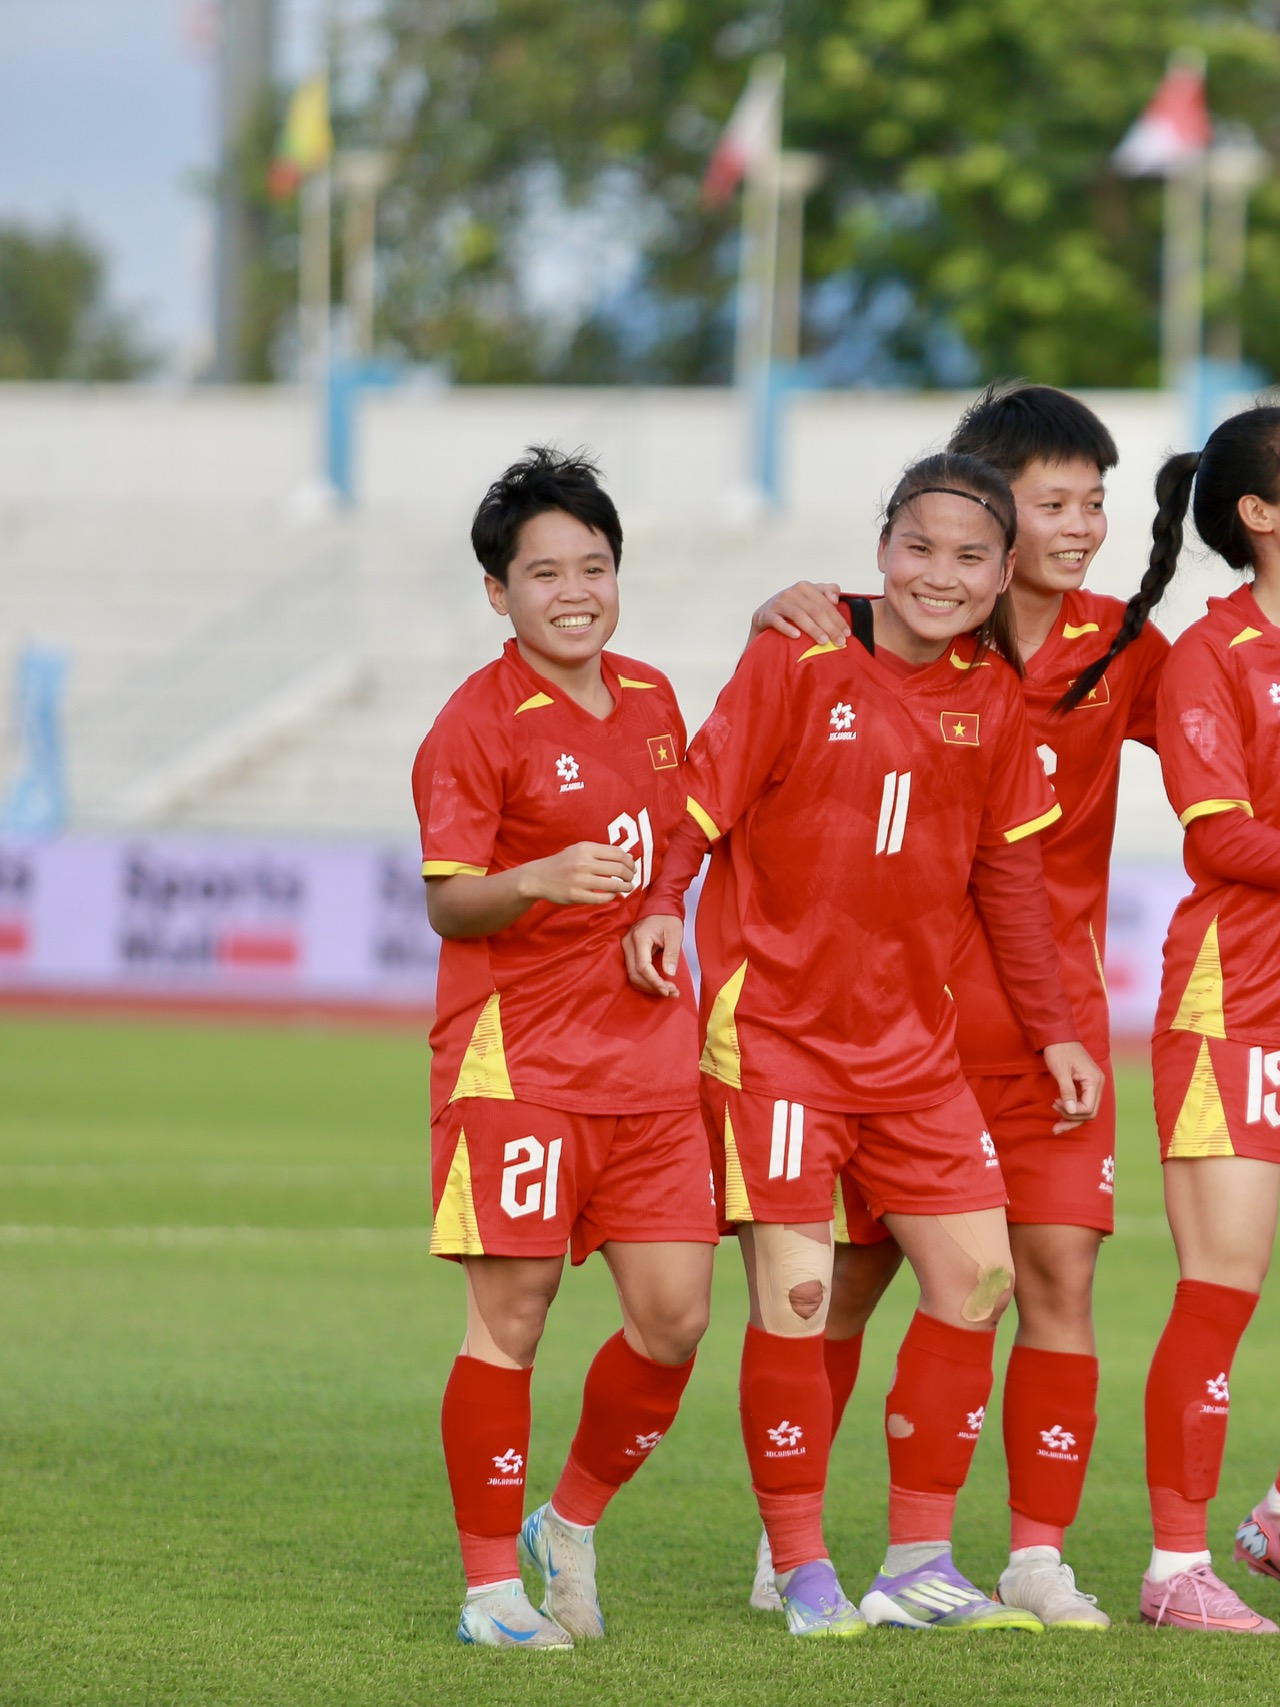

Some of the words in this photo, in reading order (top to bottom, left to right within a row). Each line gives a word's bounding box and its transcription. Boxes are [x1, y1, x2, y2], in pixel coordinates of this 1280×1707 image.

[875, 770, 912, 856] 11
[500, 1135, 563, 1221] 21
[768, 1099, 805, 1182] 11
